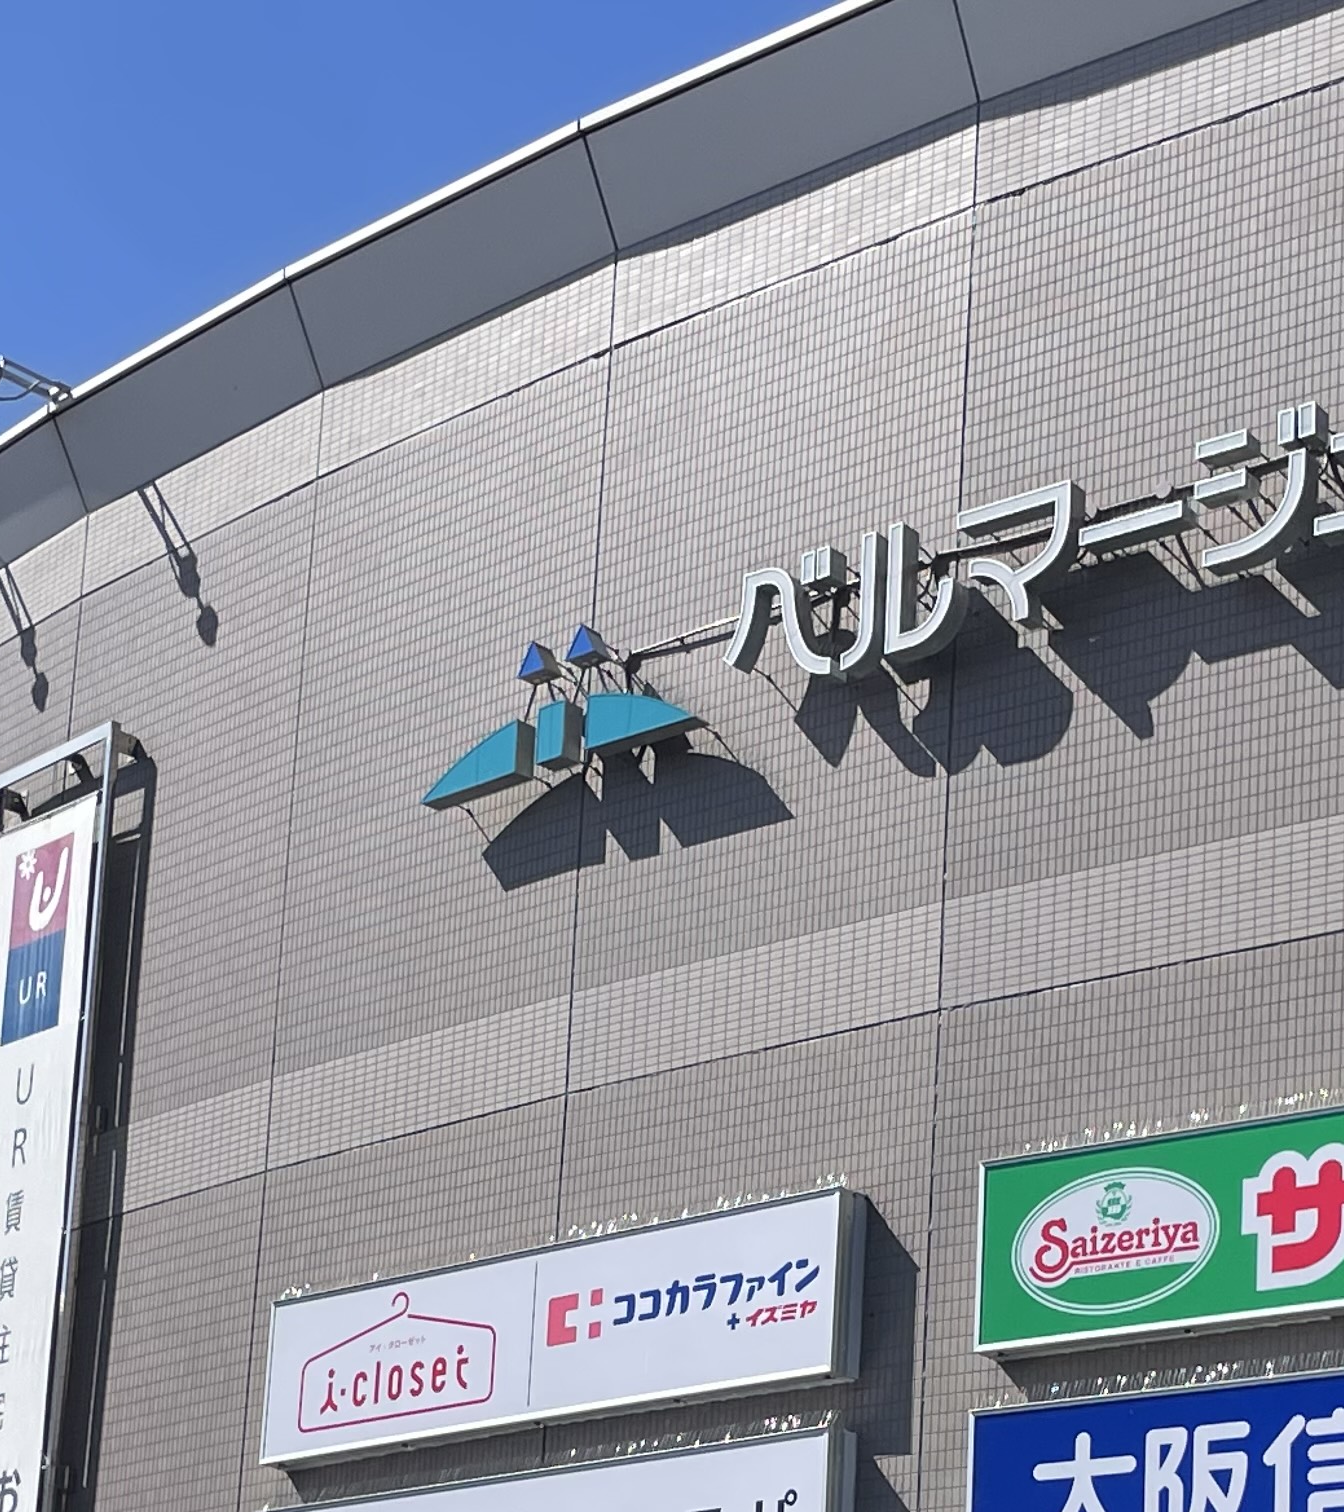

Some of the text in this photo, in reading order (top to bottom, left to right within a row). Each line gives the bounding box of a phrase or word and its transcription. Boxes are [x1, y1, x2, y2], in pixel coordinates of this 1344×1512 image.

[18, 970, 48, 1006] UR
[1030, 1217, 1200, 1282] Saizeriya
[612, 1257, 821, 1327] ココカラファイン
